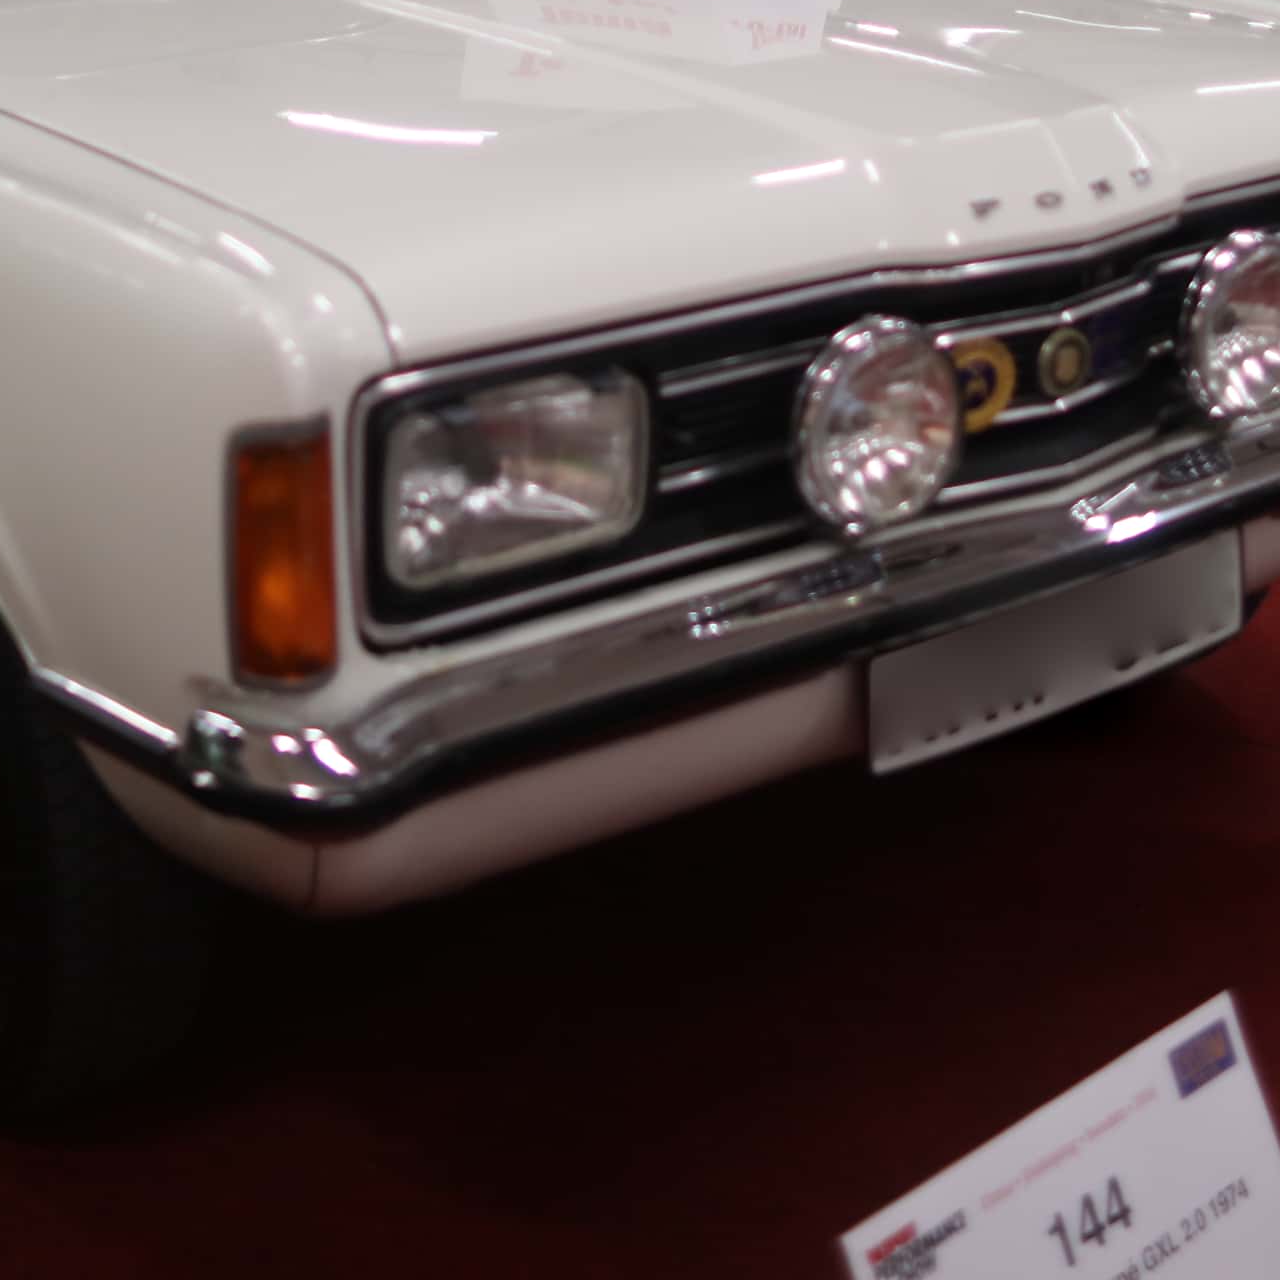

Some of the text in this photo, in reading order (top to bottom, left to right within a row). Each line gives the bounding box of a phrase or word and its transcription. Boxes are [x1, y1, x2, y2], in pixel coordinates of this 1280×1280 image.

[1047, 1174, 1133, 1268] 144
[1141, 1231, 1181, 1271] GXL
[1180, 1206, 1208, 1242] 2.0
[1208, 1177, 1250, 1219] 1974
